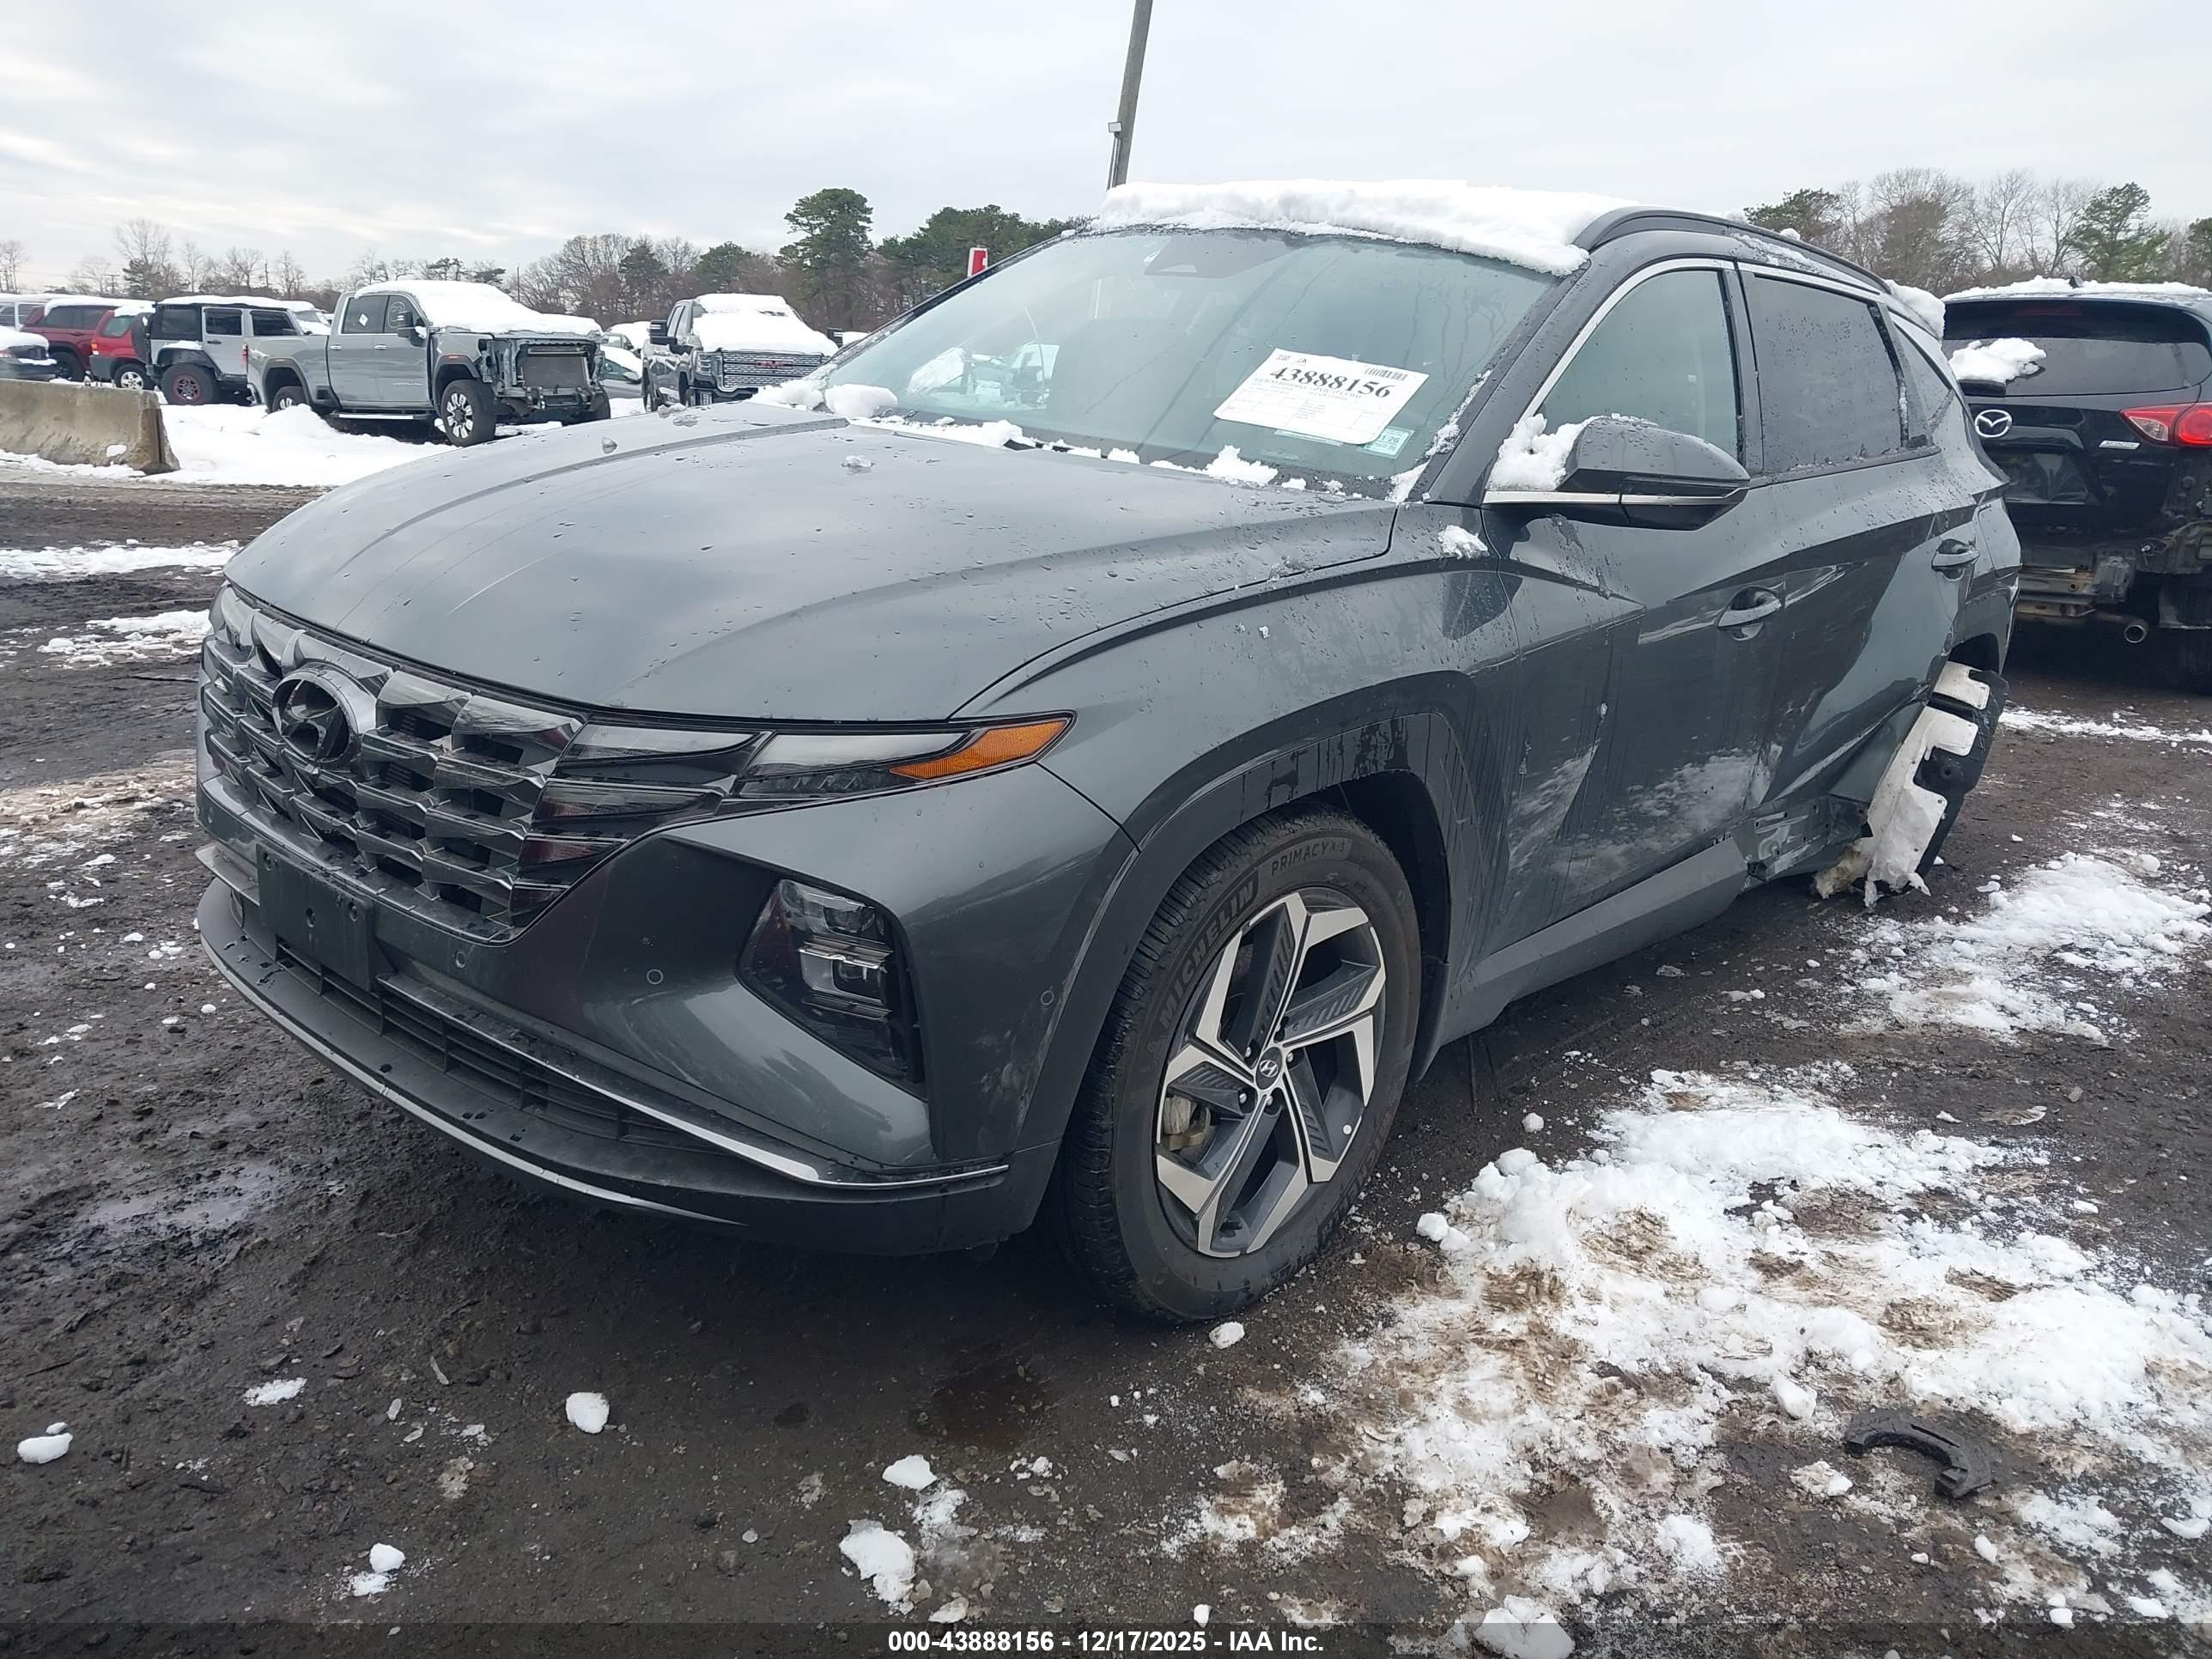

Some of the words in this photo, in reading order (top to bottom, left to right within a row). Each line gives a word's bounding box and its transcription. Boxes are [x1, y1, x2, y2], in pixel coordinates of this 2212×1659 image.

[1270, 367, 1395, 398] 43888156
[1271, 841, 1328, 877] PRIMACY
[1159, 879, 1255, 1029] MICHELIN
